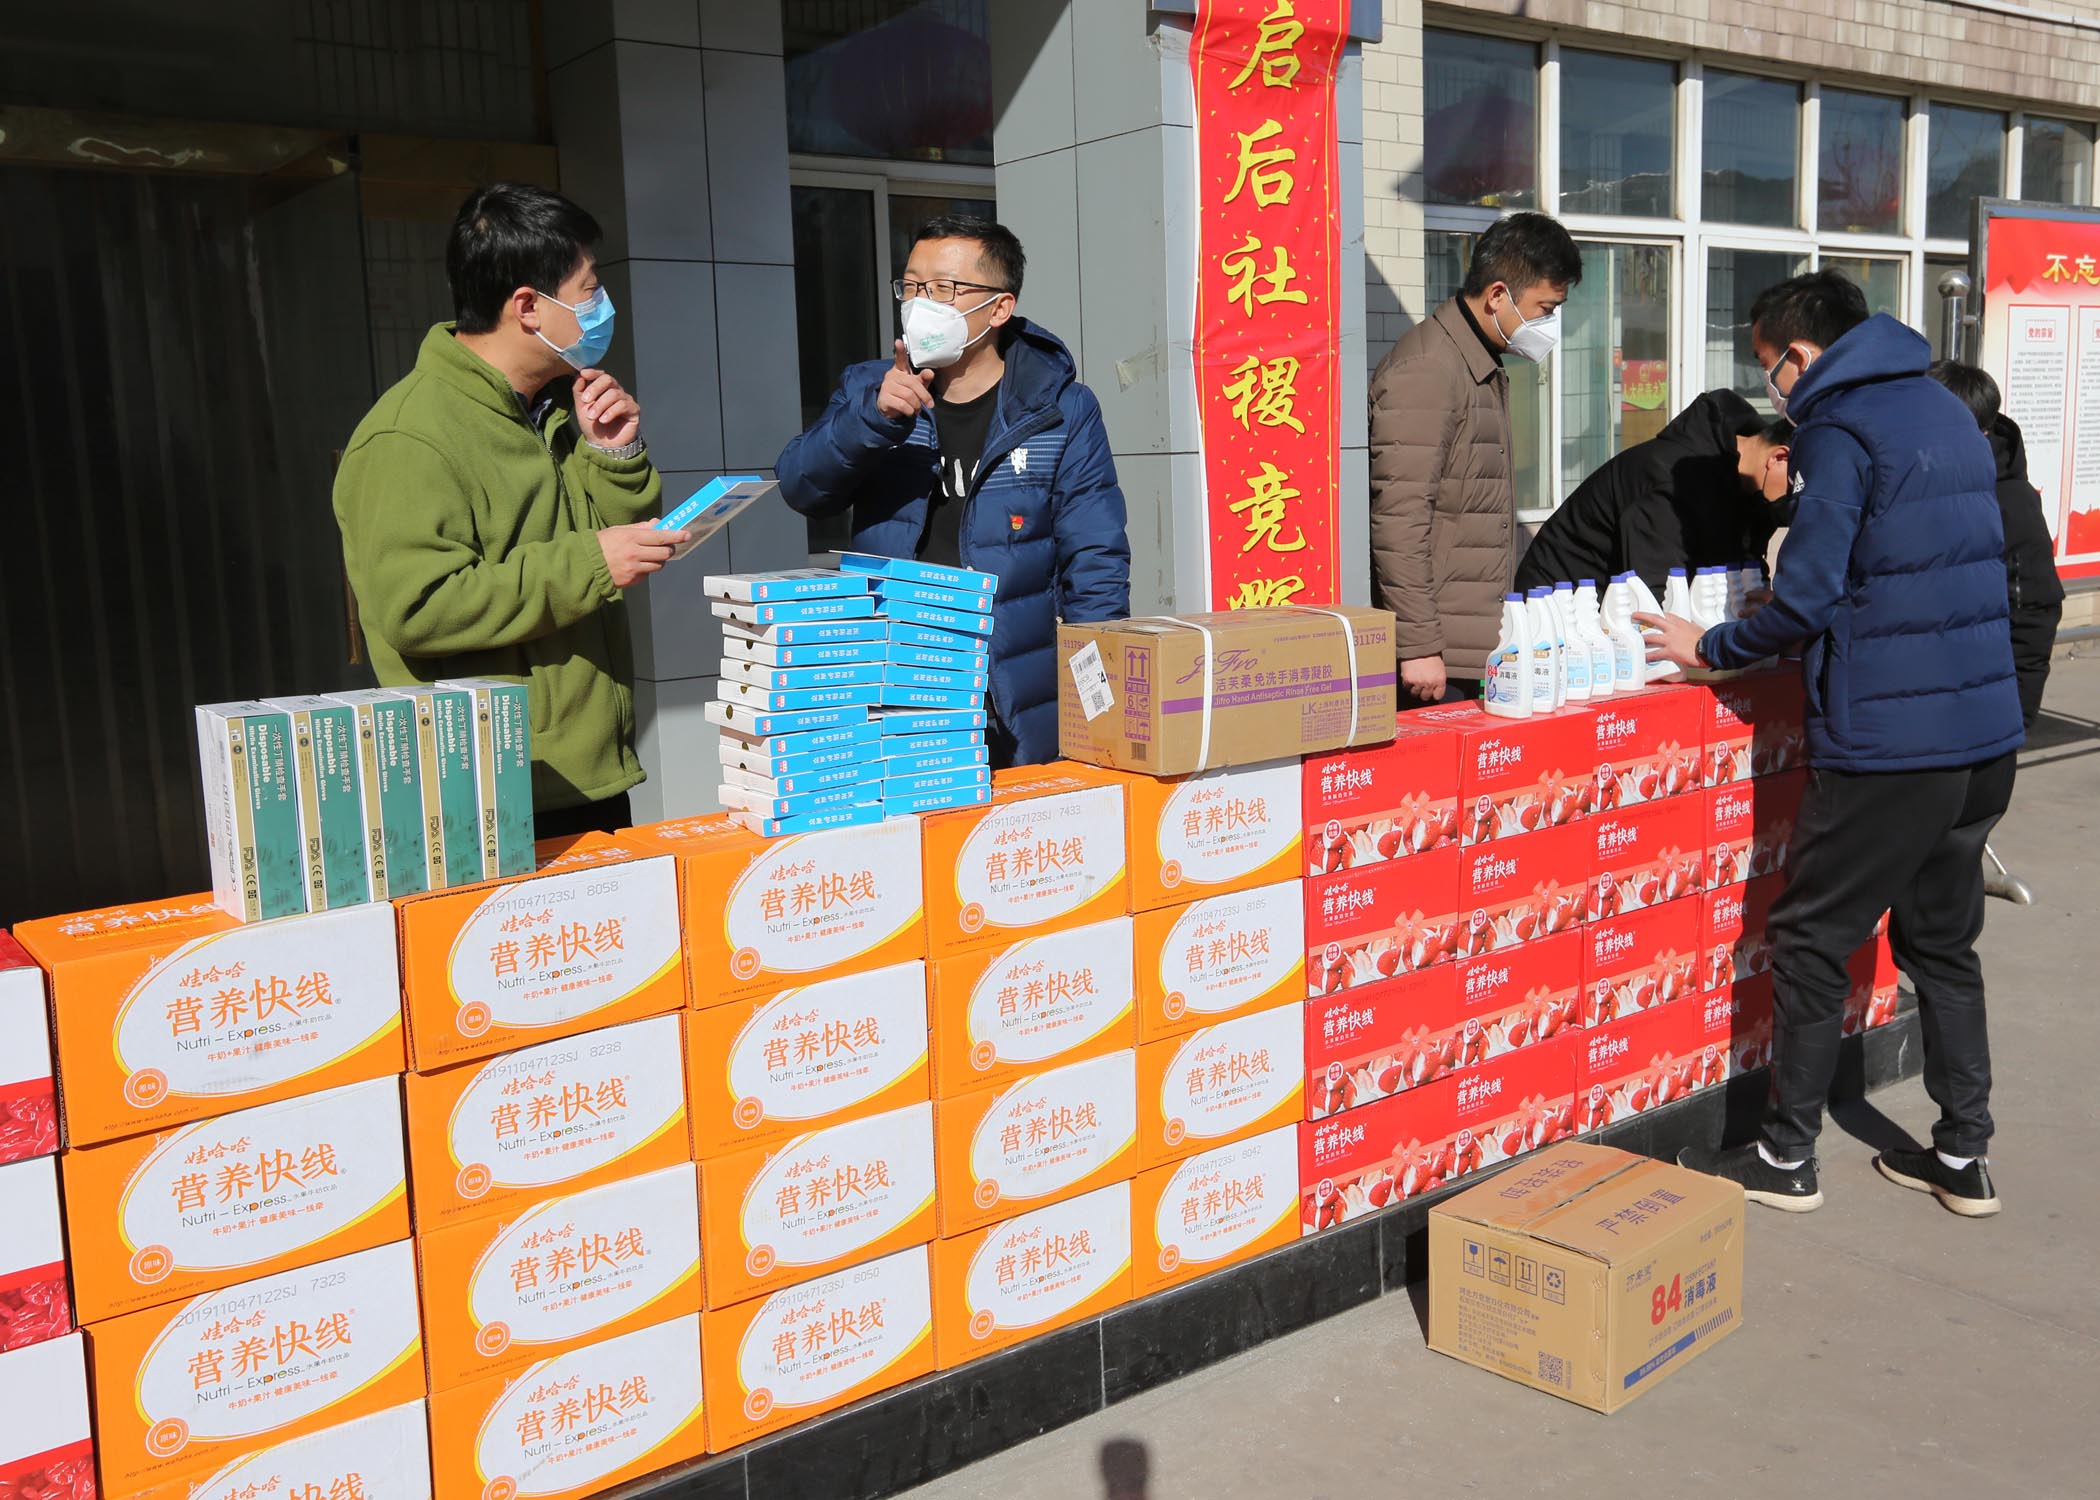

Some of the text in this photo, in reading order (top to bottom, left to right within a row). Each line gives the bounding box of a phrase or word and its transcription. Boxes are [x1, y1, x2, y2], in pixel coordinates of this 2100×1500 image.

[2041, 253, 2100, 285] 不忘
[1215, 664, 1333, 692] 洁芙柔免洗手消毒凝胶
[1487, 664, 1498, 677] 84
[1534, 667, 1550, 676] 毒液
[1232, 694, 1250, 703] Hand
[1251, 689, 1285, 701] Antiseptic
[1286, 687, 1304, 697] Rinse
[1305, 685, 1319, 696] Free
[1320, 683, 1333, 692] Gel
[386, 710, 398, 766] Disposable
[445, 699, 456, 753] Disposable
[502, 695, 512, 750] Disposable
[1596, 718, 1636, 741] 营养快线
[258, 724, 271, 783] Disposable
[317, 740, 325, 779] Examination
[324, 717, 336, 775] Disposable
[1477, 746, 1521, 770] 营养快线
[251, 747, 259, 787] Examination
[1321, 768, 1373, 794] 营养快线
[1183, 797, 1267, 839] 营养快线
[1597, 827, 1637, 850] 营养快线
[769, 860, 816, 882] 娃哈哈
[985, 837, 1084, 884] 营养快线
[1472, 858, 1516, 885] 营养快线
[587, 880, 619, 896] 8058
[760, 870, 875, 922] 营养快线
[1322, 888, 1374, 916] 营养快线
[499, 908, 553, 933] 娃哈哈
[766, 912, 840, 935] Nutri Express
[490, 918, 625, 978] 营养快线
[1185, 928, 1270, 974] 营养快线
[1595, 932, 1634, 957] 营养快线
[178, 961, 246, 989] 娃哈哈
[497, 965, 582, 992] Nutri Express
[1465, 968, 1508, 995] 营养快线
[166, 971, 332, 1037] 营养快线
[997, 968, 1094, 1017] 营养快线
[772, 1008, 819, 1031] 娃哈哈
[1323, 1008, 1374, 1038] 营养快线
[176, 1022, 282, 1053] Nutri Express
[589, 1041, 622, 1057] 8238
[763, 1016, 880, 1072] 营养快线
[1588, 1037, 1628, 1064] 营养快线
[500, 1070, 555, 1096] 娃哈哈
[1186, 1048, 1270, 1096] 营养快线
[1457, 1078, 1502, 1107] 营养快线
[491, 1078, 627, 1140] 营养快线
[498, 1124, 584, 1153] Nutri Express
[1000, 1102, 1097, 1155] 营养快线
[1314, 1124, 1364, 1156] 营养快线
[184, 1136, 251, 1165] 娃哈哈
[784, 1154, 830, 1179] 娃哈哈
[171, 1143, 338, 1214] 营养快线
[775, 1160, 889, 1219] 营养快线
[182, 1195, 287, 1228] Nutri Express
[1180, 1176, 1264, 1226] 营养快线
[1596, 1188, 1686, 1236] 严禁倒置
[520, 1223, 575, 1250] 娃哈哈
[510, 1227, 644, 1293] 营养快线
[995, 1229, 1091, 1286] 营养快线
[310, 1271, 347, 1292] 7323
[518, 1274, 603, 1306] Nutri Express
[780, 1299, 825, 1325] 娃哈哈
[1651, 1273, 1682, 1326] 84
[1683, 1271, 1717, 1308] 消毒液
[200, 1310, 265, 1341] 娃哈哈
[772, 1301, 885, 1366] 营养快线
[188, 1312, 352, 1390] 营养快线
[196, 1366, 300, 1404] Nutri Express
[526, 1375, 580, 1403] 娃哈哈
[516, 1375, 649, 1447] 营养快线
[524, 1424, 608, 1460] Nutri Express
